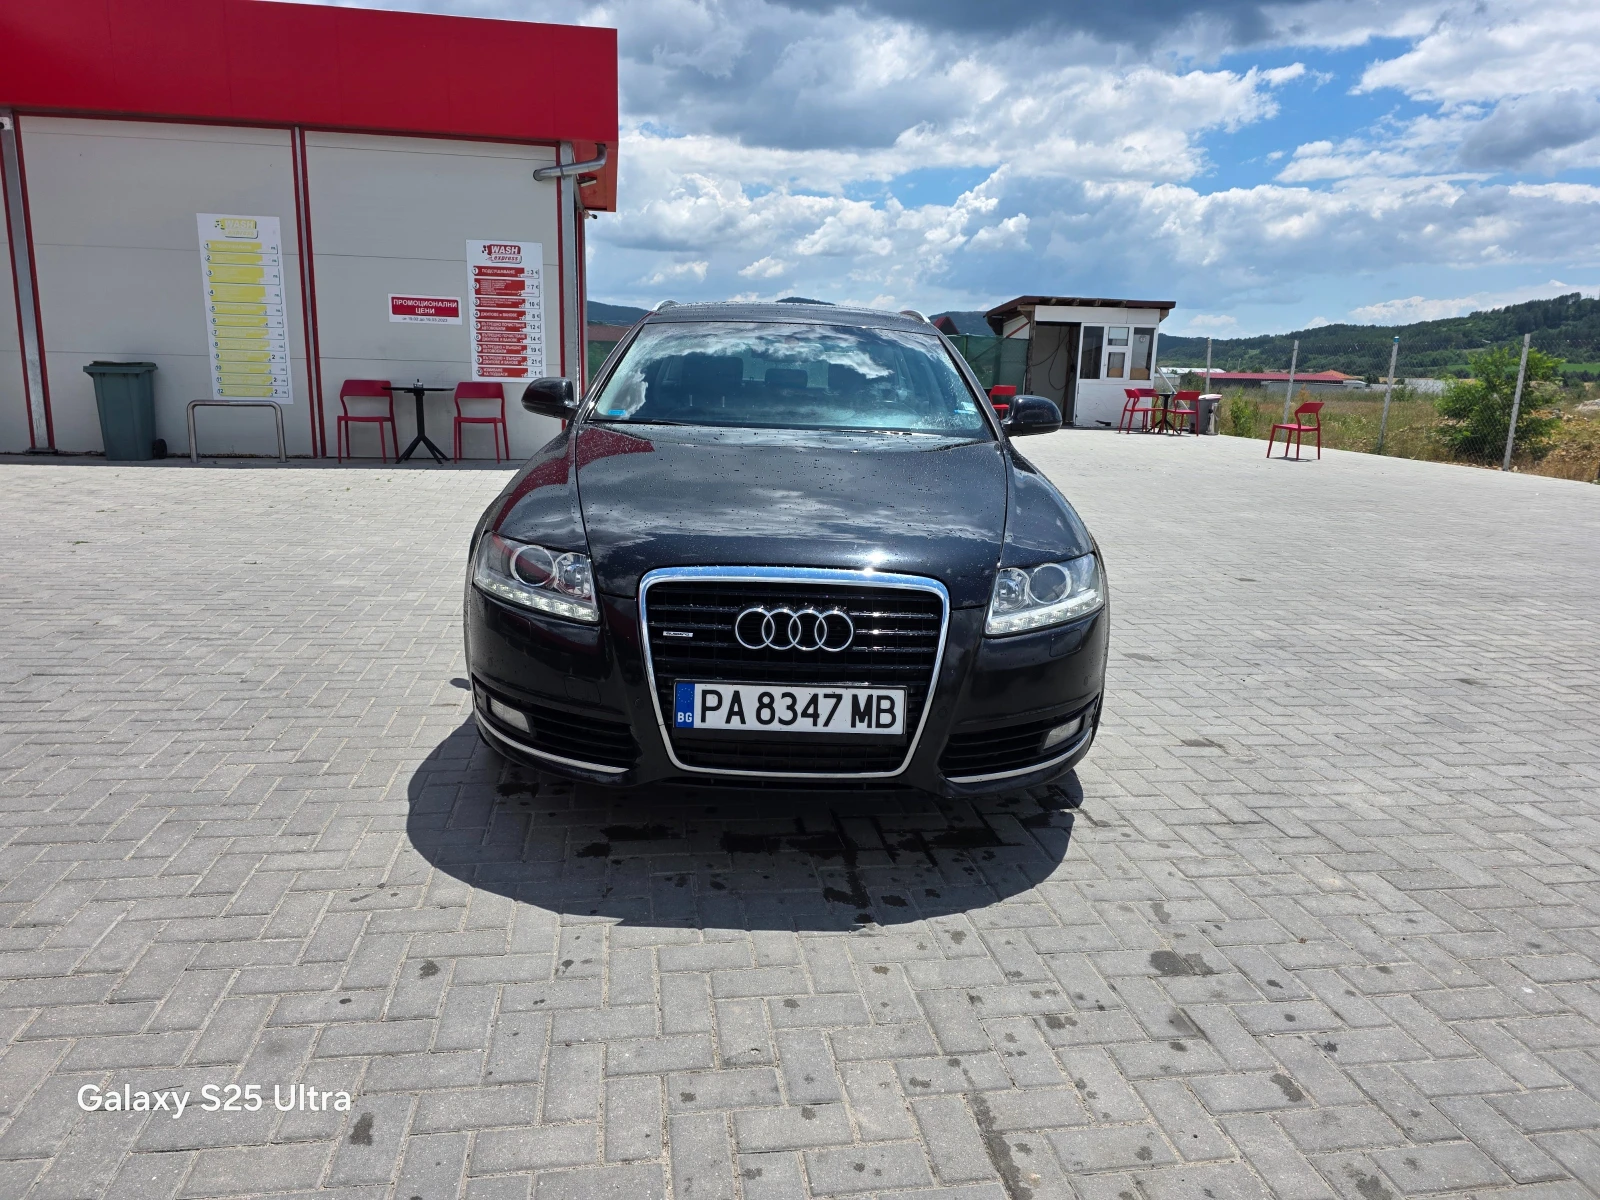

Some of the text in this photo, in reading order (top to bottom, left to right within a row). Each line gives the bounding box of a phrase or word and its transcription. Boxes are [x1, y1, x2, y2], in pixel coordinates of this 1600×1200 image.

[225, 220, 254, 228] WASH
[491, 246, 518, 254] WASH
[393, 299, 457, 308] ПРОМОЦИОНАЛНИ
[700, 689, 897, 729] PA 8347 MB
[677, 712, 693, 723] BG
